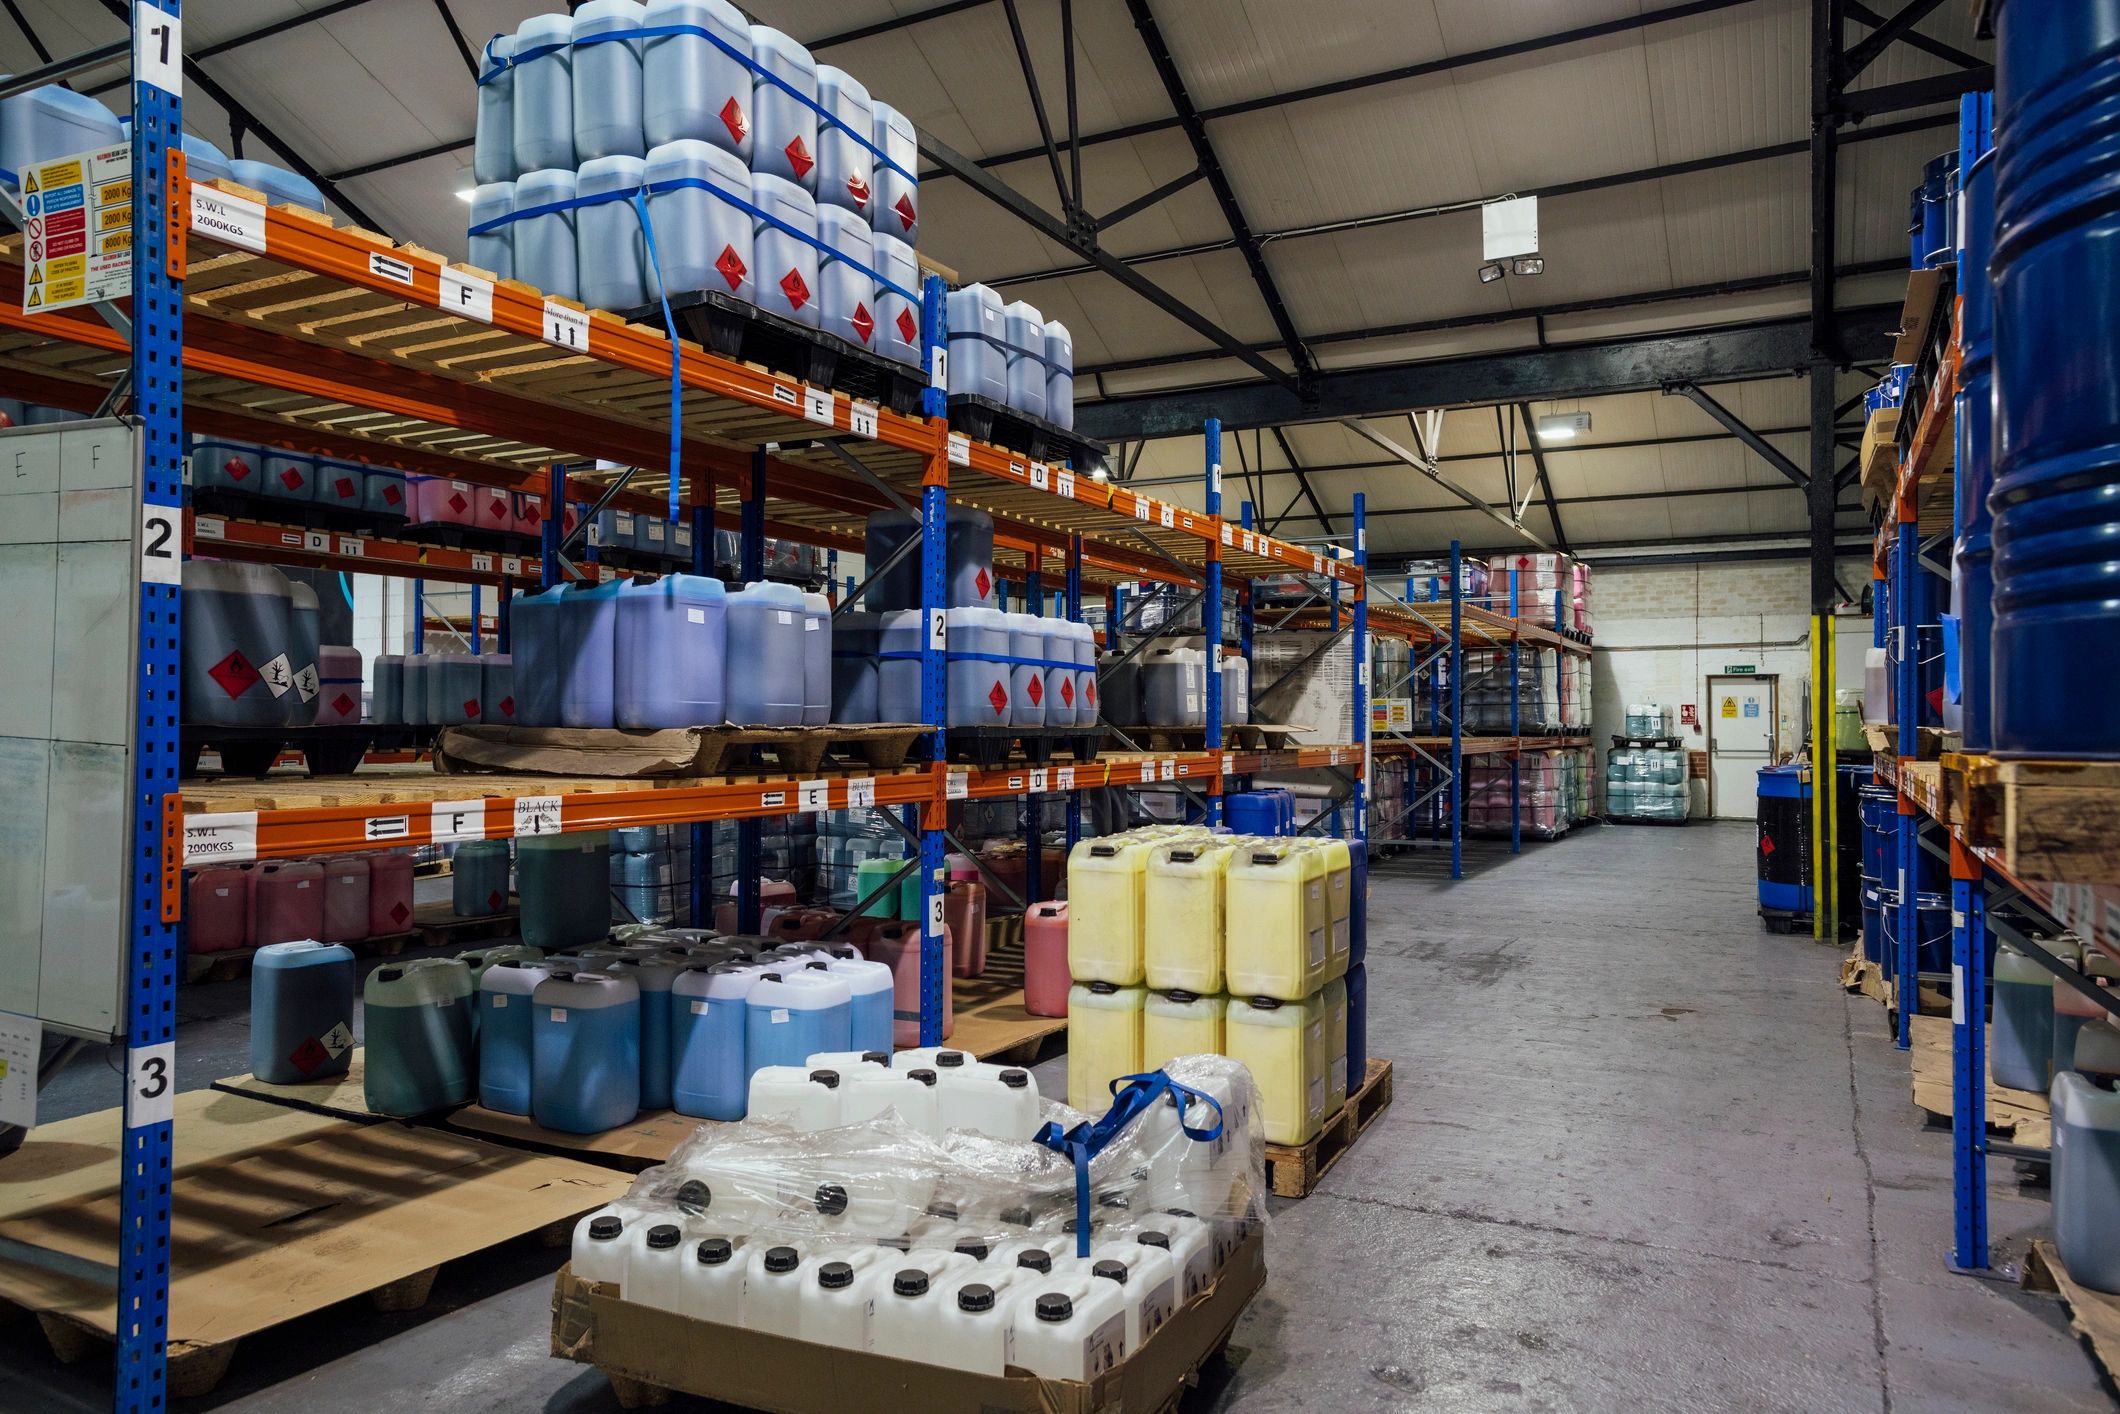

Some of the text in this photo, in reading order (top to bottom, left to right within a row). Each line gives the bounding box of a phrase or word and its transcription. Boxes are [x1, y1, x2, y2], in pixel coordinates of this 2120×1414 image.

[151, 24, 170, 65] 1
[104, 188, 120, 200] 2000
[196, 199, 226, 216] S.W.L
[104, 213, 120, 225] 2000
[197, 214, 244, 236] 2000KGS
[461, 286, 473, 305] F
[939, 354, 944, 376] 1
[816, 400, 824, 416] E
[16, 452, 26, 477] E
[92, 445, 100, 469] F
[182, 460, 188, 476] 1
[144, 518, 172, 558] 2
[313, 536, 321, 546] D
[592, 527, 595, 538] 1
[936, 615, 944, 636] 2
[1216, 649, 1221, 663] 2
[810, 790, 817, 804] E
[518, 800, 558, 813] BLACK
[453, 813, 464, 833] F
[188, 827, 217, 838] S.W.L
[188, 842, 234, 854] 2000KGS
[935, 901, 942, 922] 3
[140, 1057, 168, 1098] 3
